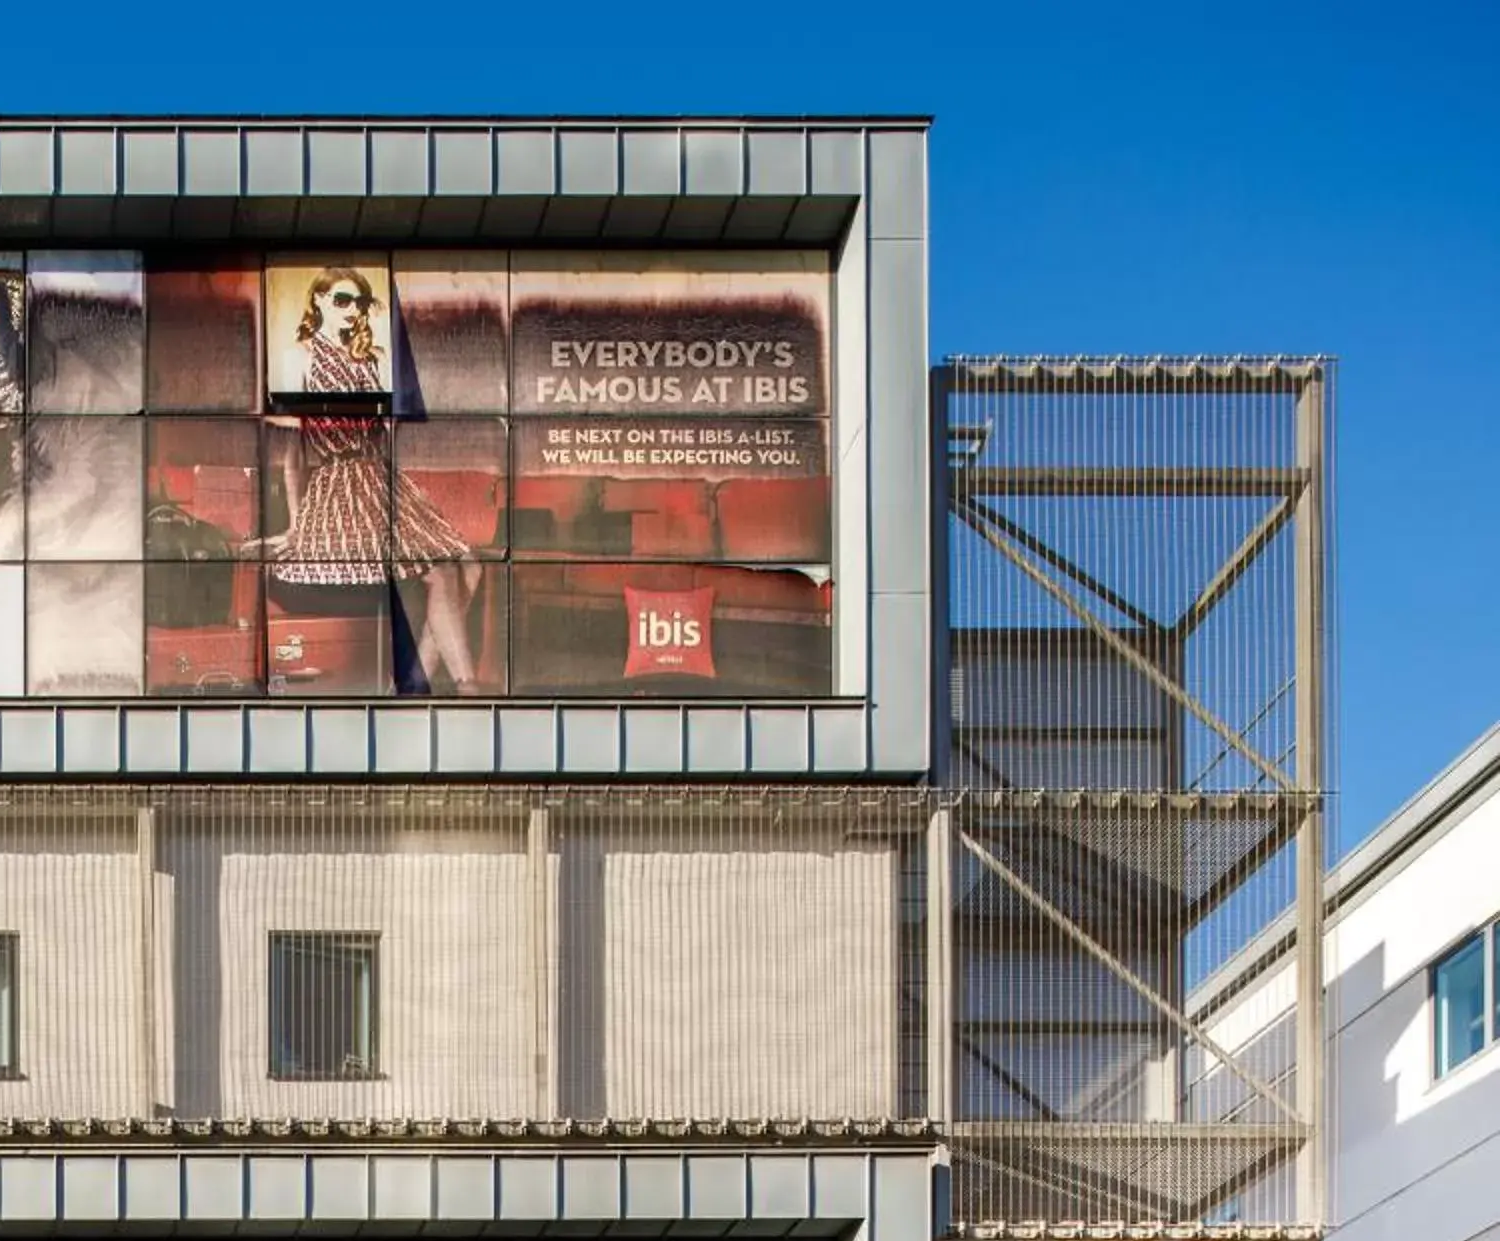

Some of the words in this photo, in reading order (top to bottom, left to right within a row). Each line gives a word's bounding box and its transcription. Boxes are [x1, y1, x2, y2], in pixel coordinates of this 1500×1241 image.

[551, 341, 795, 368] EVERYBODY'S
[537, 376, 683, 404] FAMOUS
[691, 376, 733, 404] AT
[743, 376, 810, 404] IBIS
[548, 430, 572, 445] BE
[576, 430, 623, 445] NEXT
[627, 430, 655, 445] ON
[660, 430, 694, 445] THE
[699, 429, 733, 445] IBIS
[542, 450, 571, 465] WE
[576, 450, 619, 465] WILL
[624, 450, 647, 465] BE
[651, 450, 752, 465] EXPECTING
[757, 450, 801, 465] YOU.
[638, 612, 701, 647] ibis
